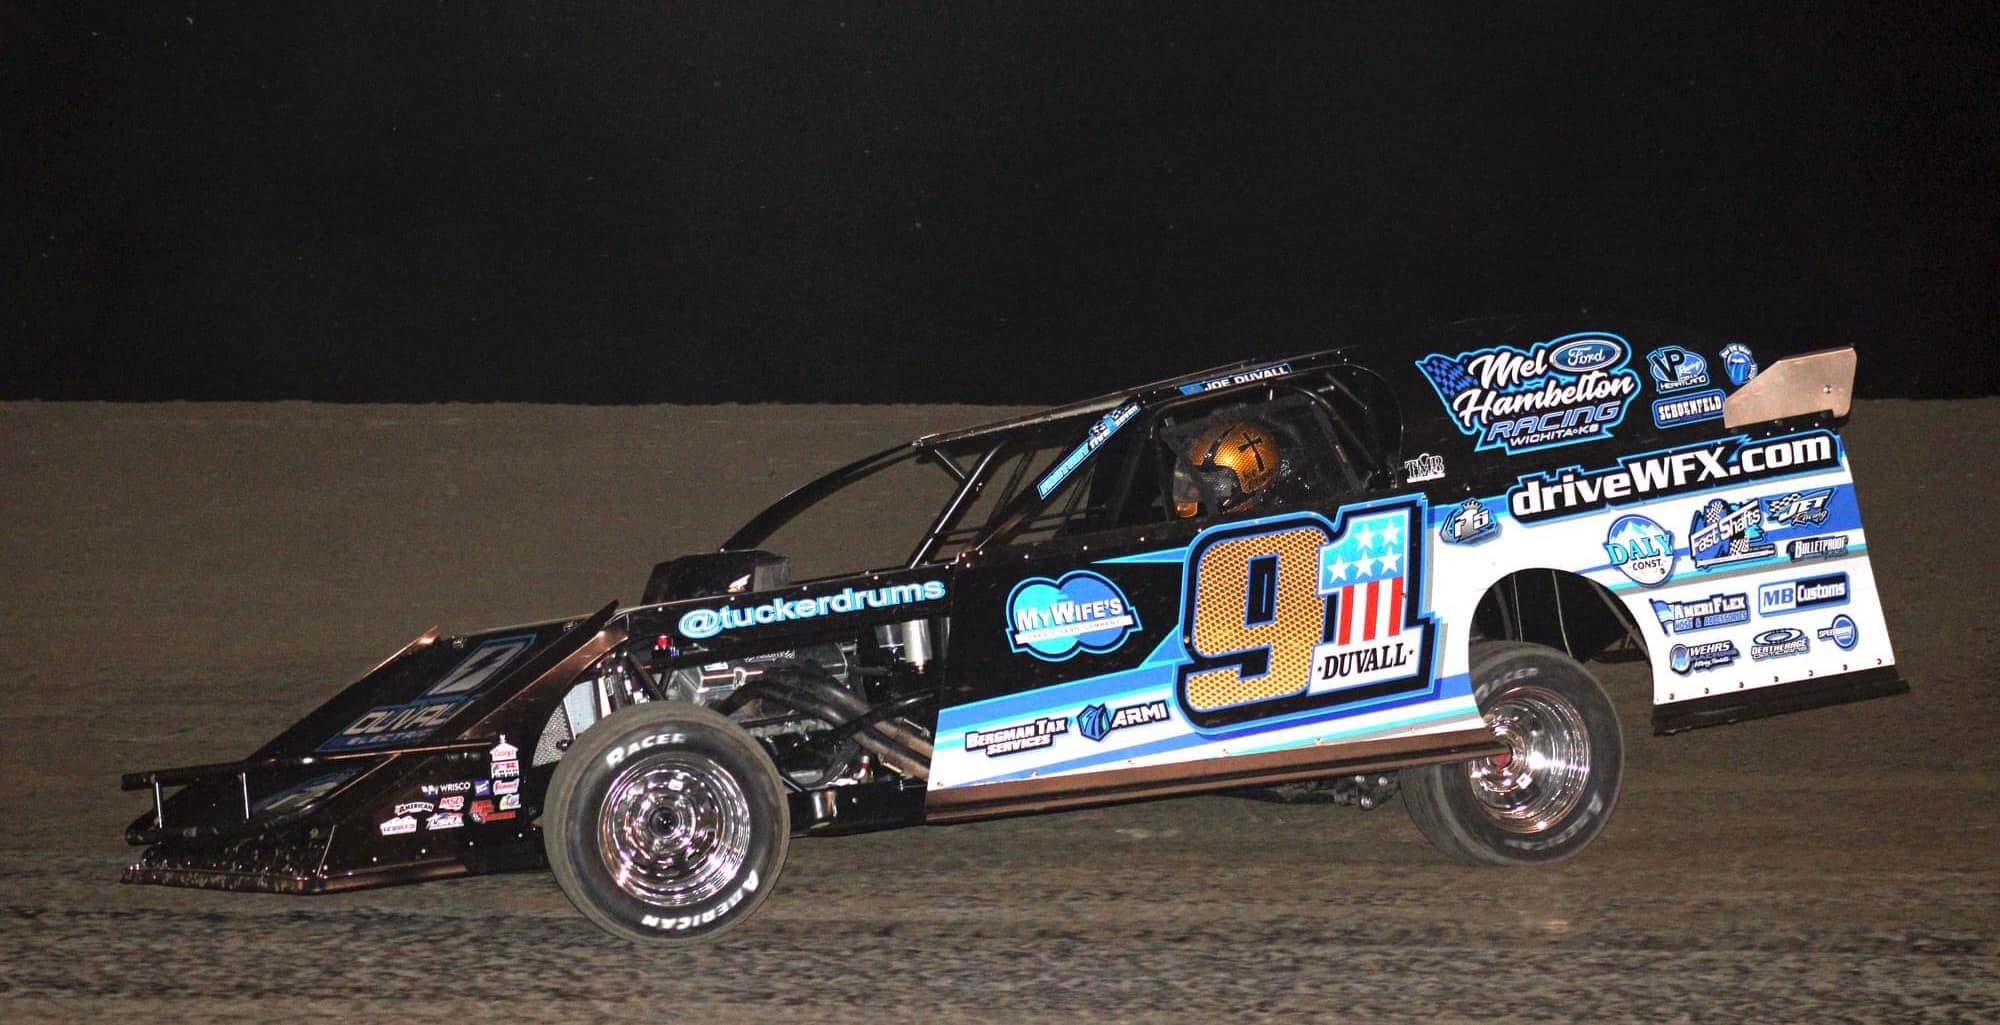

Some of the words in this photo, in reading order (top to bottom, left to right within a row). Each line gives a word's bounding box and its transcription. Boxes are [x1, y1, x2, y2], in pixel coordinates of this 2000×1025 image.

[1467, 349, 1548, 389] Mel
[1567, 346, 1606, 366] Ford
[1651, 350, 1685, 383] VP
[1204, 379, 1230, 392] JOE
[1235, 366, 1289, 386] DUVALL
[1452, 370, 1635, 427] Hambelton
[1658, 395, 1722, 421] SCHOENFELD
[1487, 400, 1621, 441] RACING
[1512, 436, 1831, 517] driveWFX.com
[1691, 523, 1719, 557] Fast
[1719, 500, 1761, 541] Shafts
[1606, 533, 1673, 566] DALY
[678, 580, 946, 638] @tuckerdrums
[1184, 508, 1424, 712] 91
[1763, 587, 1793, 606] MB
[1797, 582, 1845, 602] Customs
[1322, 643, 1408, 681] DUVALL
[1111, 703, 1168, 729] ARMI
[605, 733, 687, 768] RACER
[440, 782, 471, 793] WRISCO
[641, 869, 759, 930] AMERICAN
